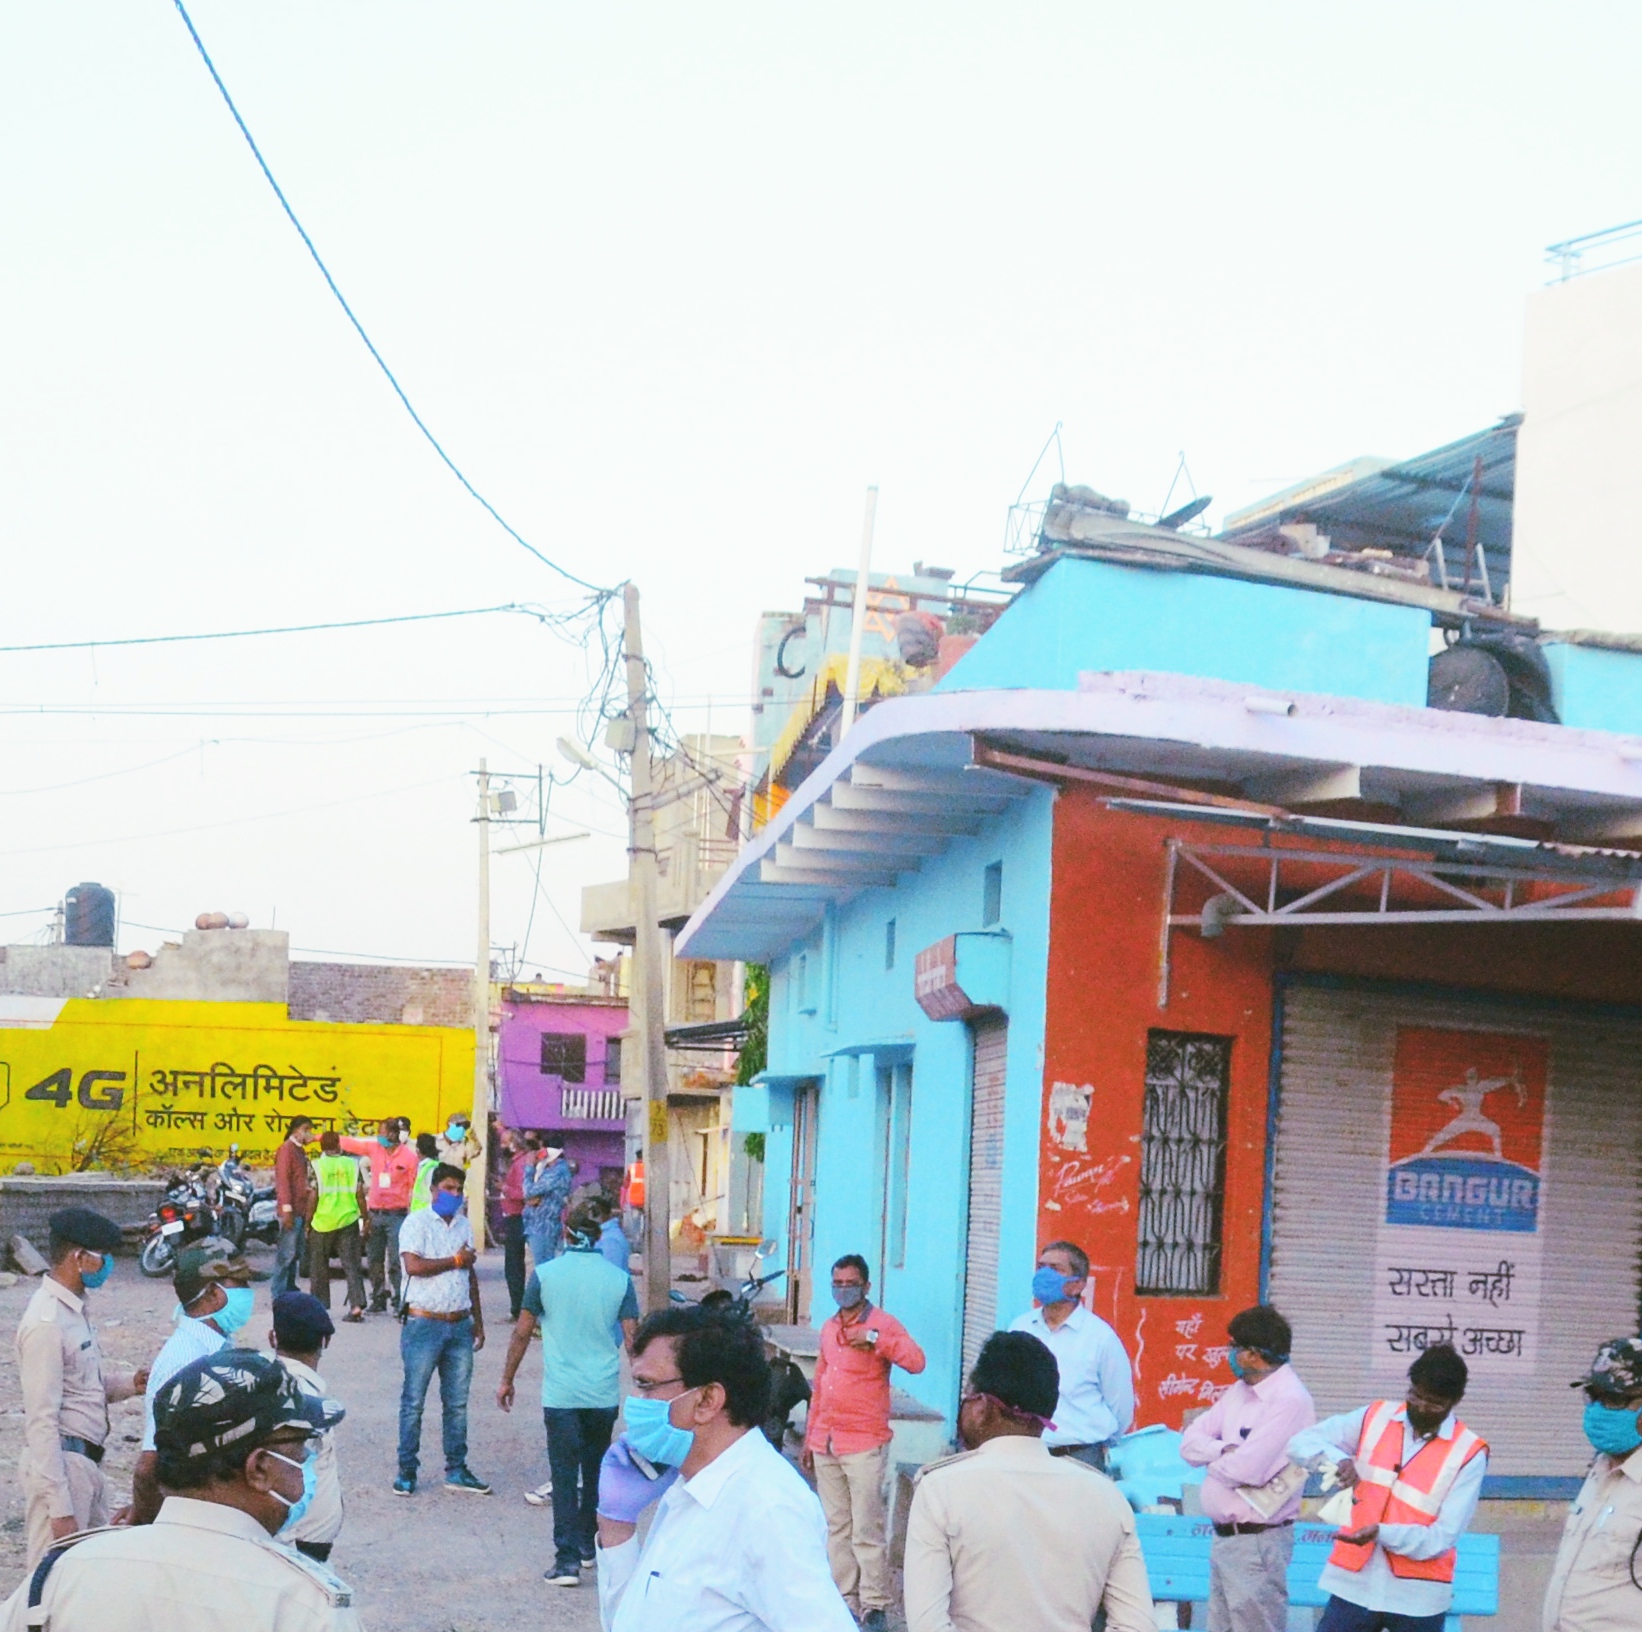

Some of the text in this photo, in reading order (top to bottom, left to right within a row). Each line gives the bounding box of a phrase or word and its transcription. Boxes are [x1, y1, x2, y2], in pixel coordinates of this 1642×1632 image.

[25, 1067, 126, 1111] 4G
[145, 1103, 207, 1131] कॉल्स
[214, 1107, 256, 1133] और
[1393, 1170, 1535, 1209] BANGUR
[1467, 1260, 1516, 1308] नहीं
[1461, 1327, 1526, 1357] अच्छा
